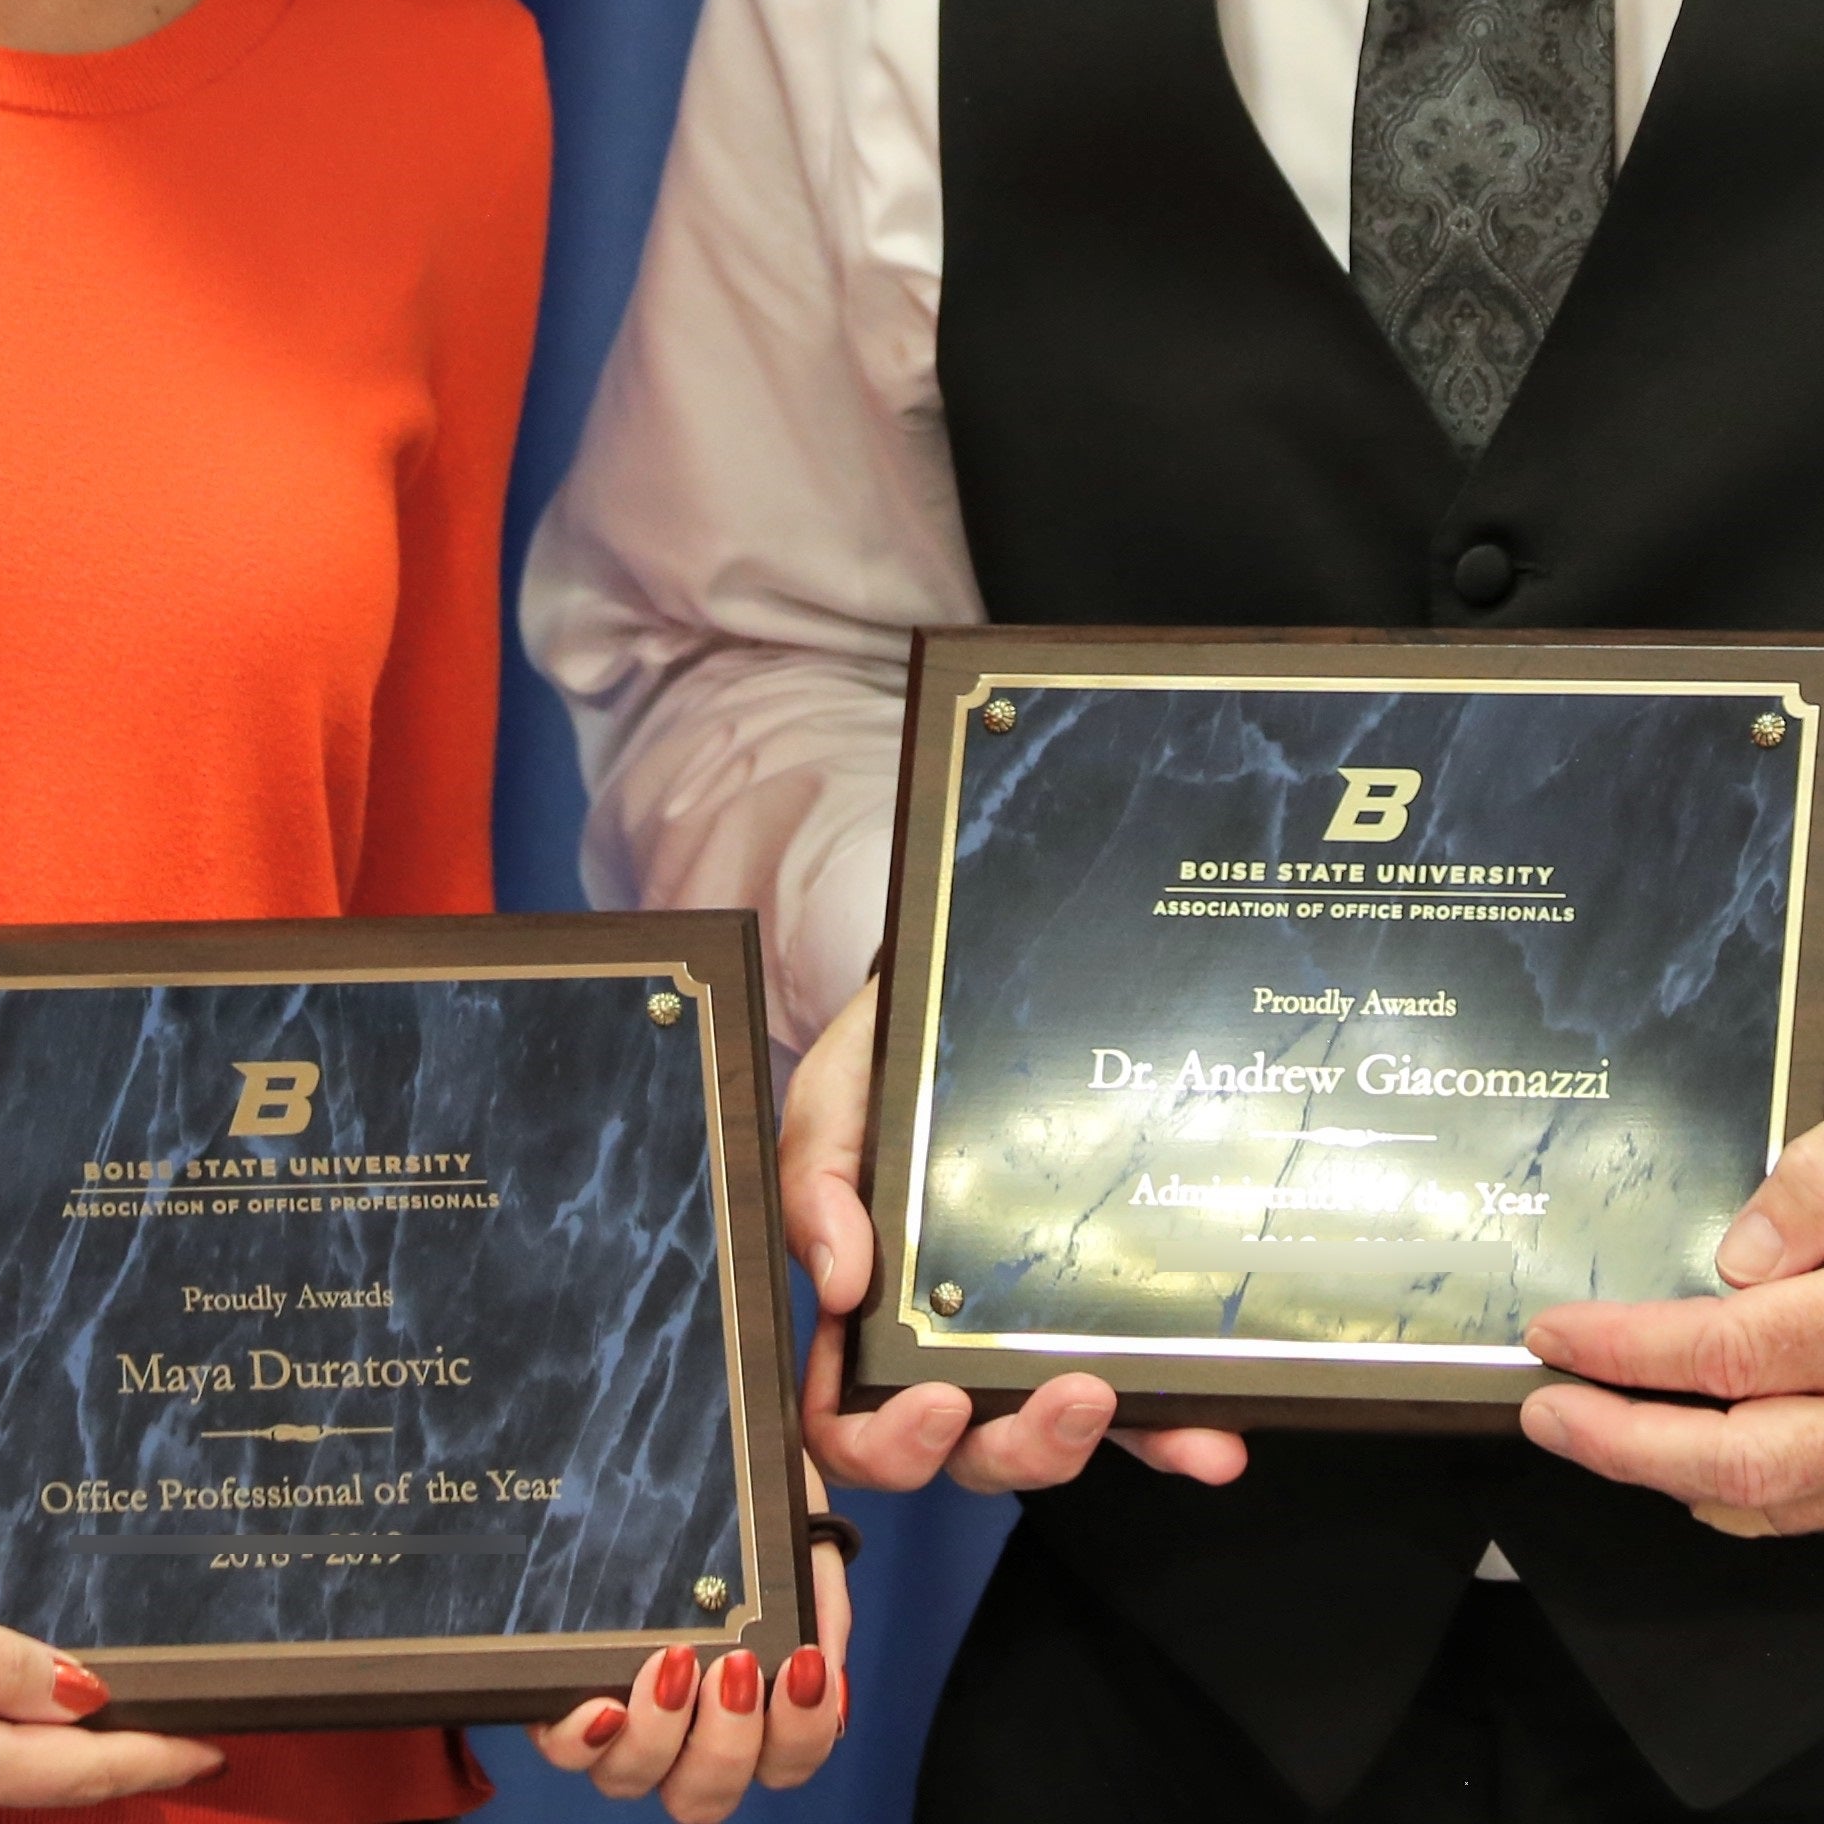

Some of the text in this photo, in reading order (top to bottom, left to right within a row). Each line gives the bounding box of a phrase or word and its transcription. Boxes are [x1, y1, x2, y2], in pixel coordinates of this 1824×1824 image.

[1322, 766, 1422, 842] B
[1179, 861, 1556, 887] BOISE STATE UNIVERSITY
[1152, 899, 1575, 923] ASSOCIATION OF OFFICE PROFESSIONALS
[1253, 987, 1457, 1021] Proudly Awards
[1087, 1048, 1611, 1100] Dr. Andrew Giacomazzi
[228, 1060, 320, 1137] B
[84, 1153, 471, 1181] BOISE STATE UNIVERSITY
[62, 1193, 500, 1217] ASSOCIATION OF OFFICE PROFESSIONALS
[1475, 1182, 1550, 1215] Year
[182, 1283, 394, 1318] Proudly Awards
[117, 1345, 471, 1404] Maya Duratovic
[40, 1469, 562, 1514] Office Professional of the Year
